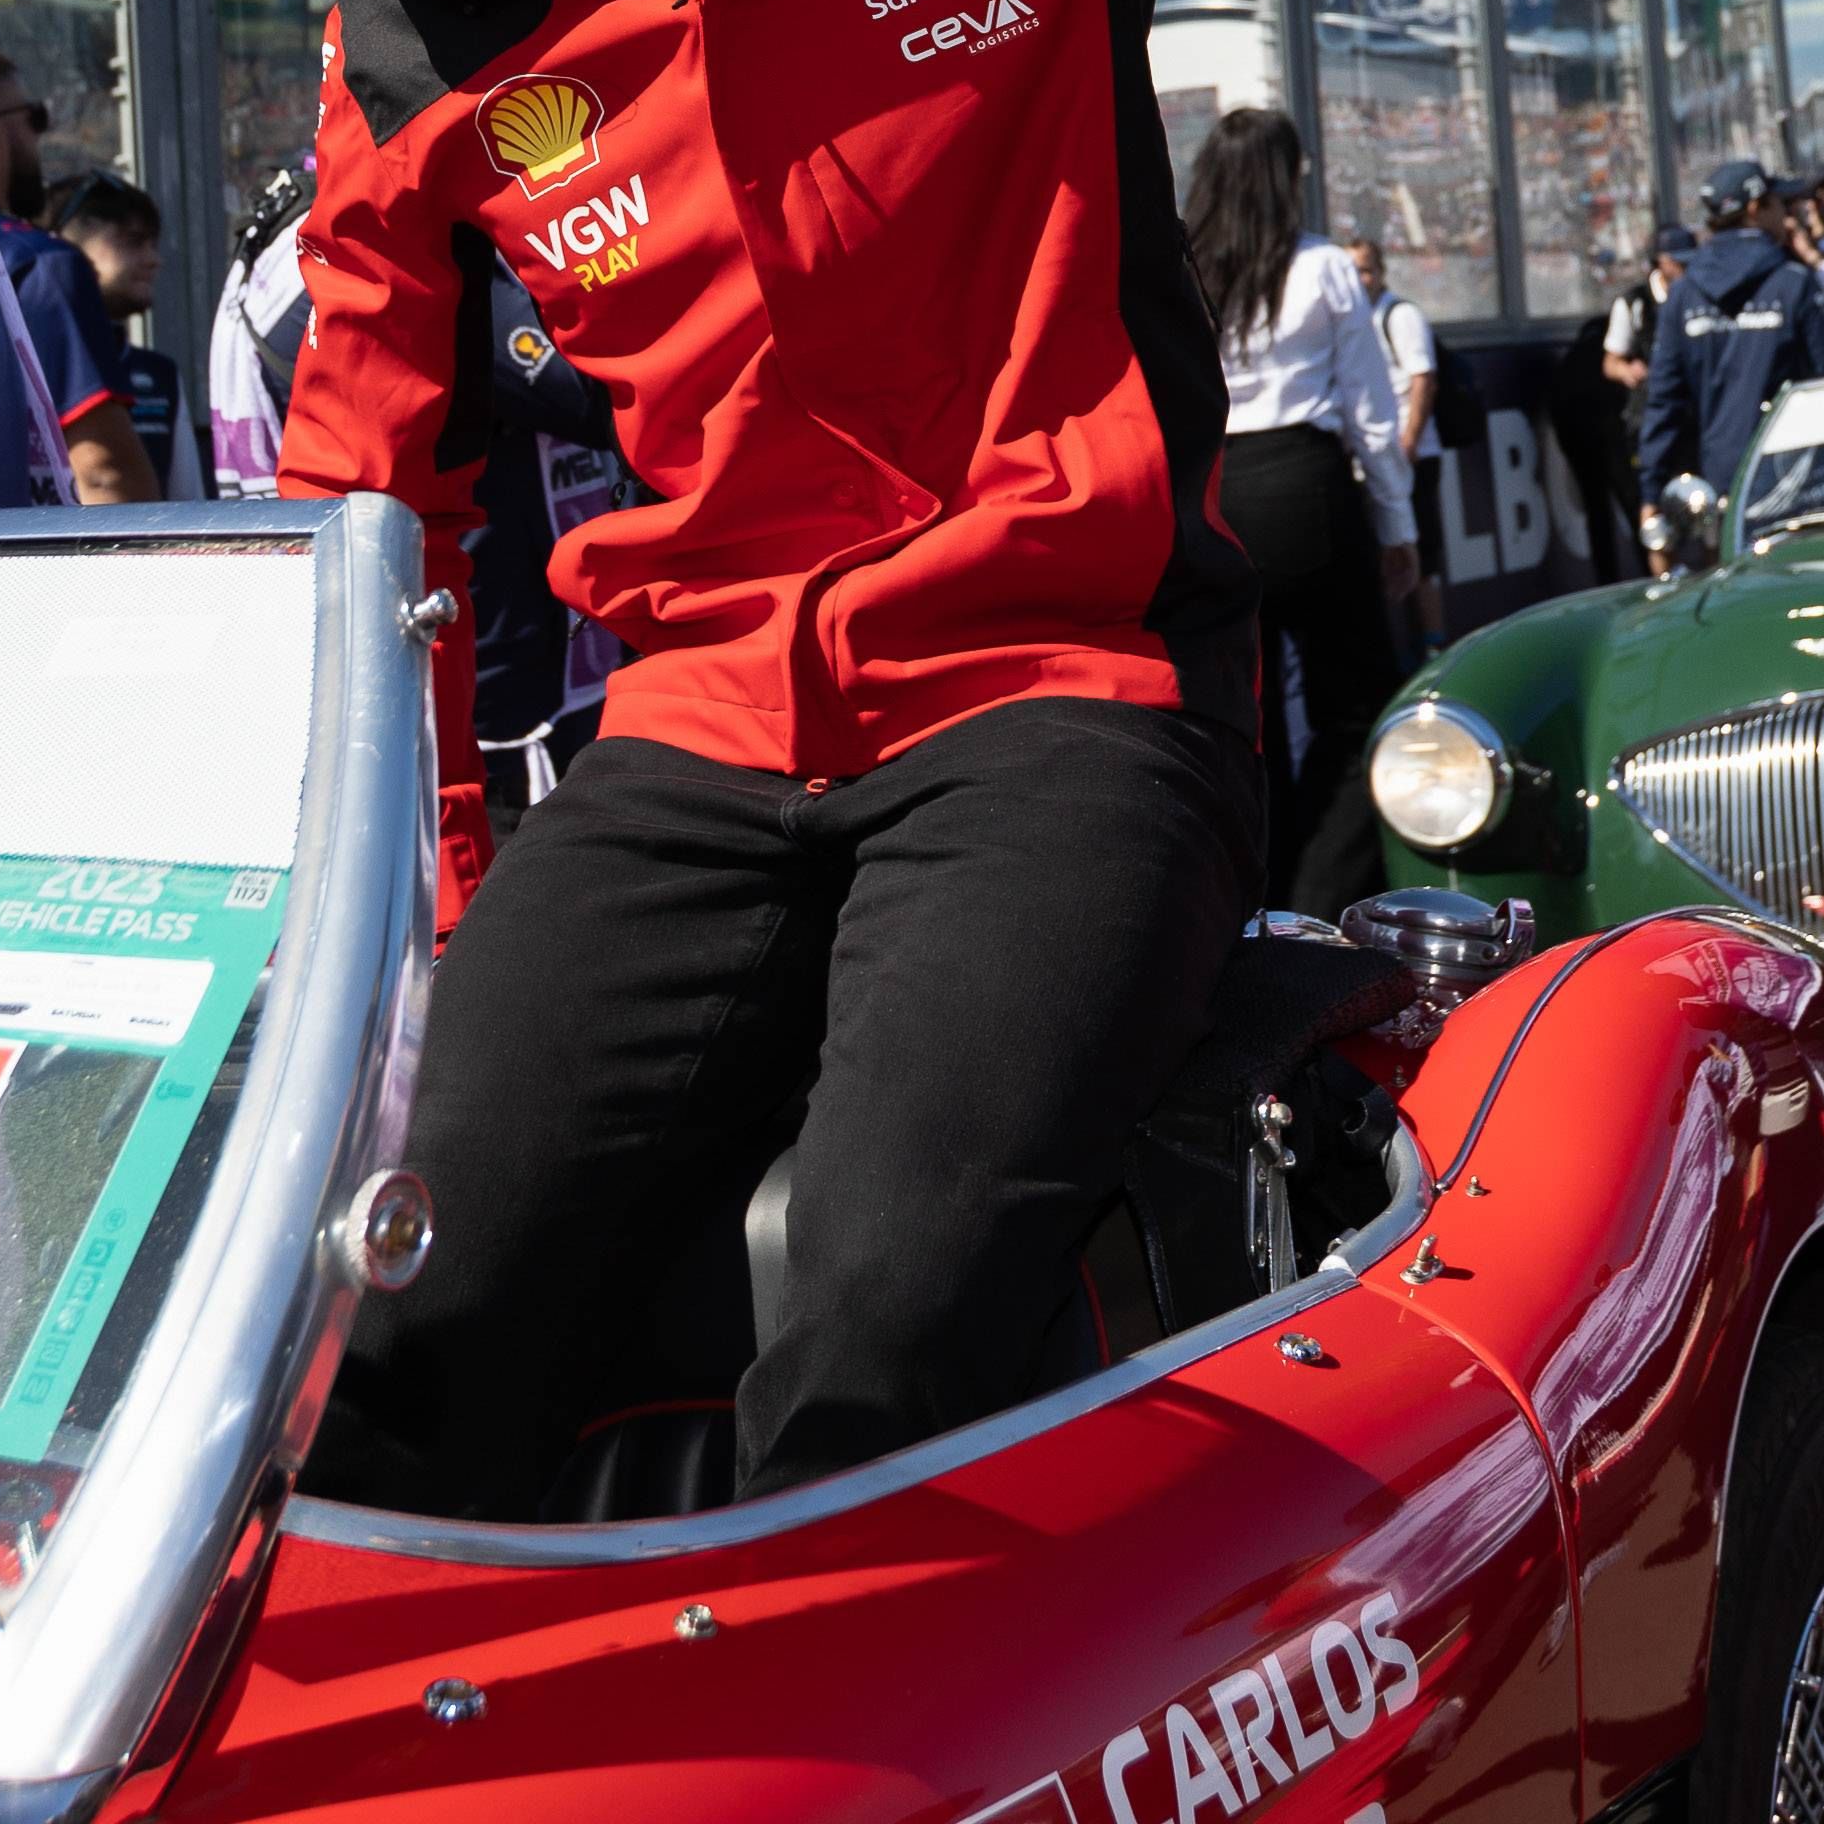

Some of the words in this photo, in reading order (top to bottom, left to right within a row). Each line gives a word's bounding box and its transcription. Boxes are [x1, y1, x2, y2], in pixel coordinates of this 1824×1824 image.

[968, 17, 1040, 54] LOGISTICS
[524, 173, 650, 271] VGW
[573, 235, 640, 293] PLAY
[108, 911, 199, 942] PASS
[1102, 1591, 1420, 1824] CARLOS
